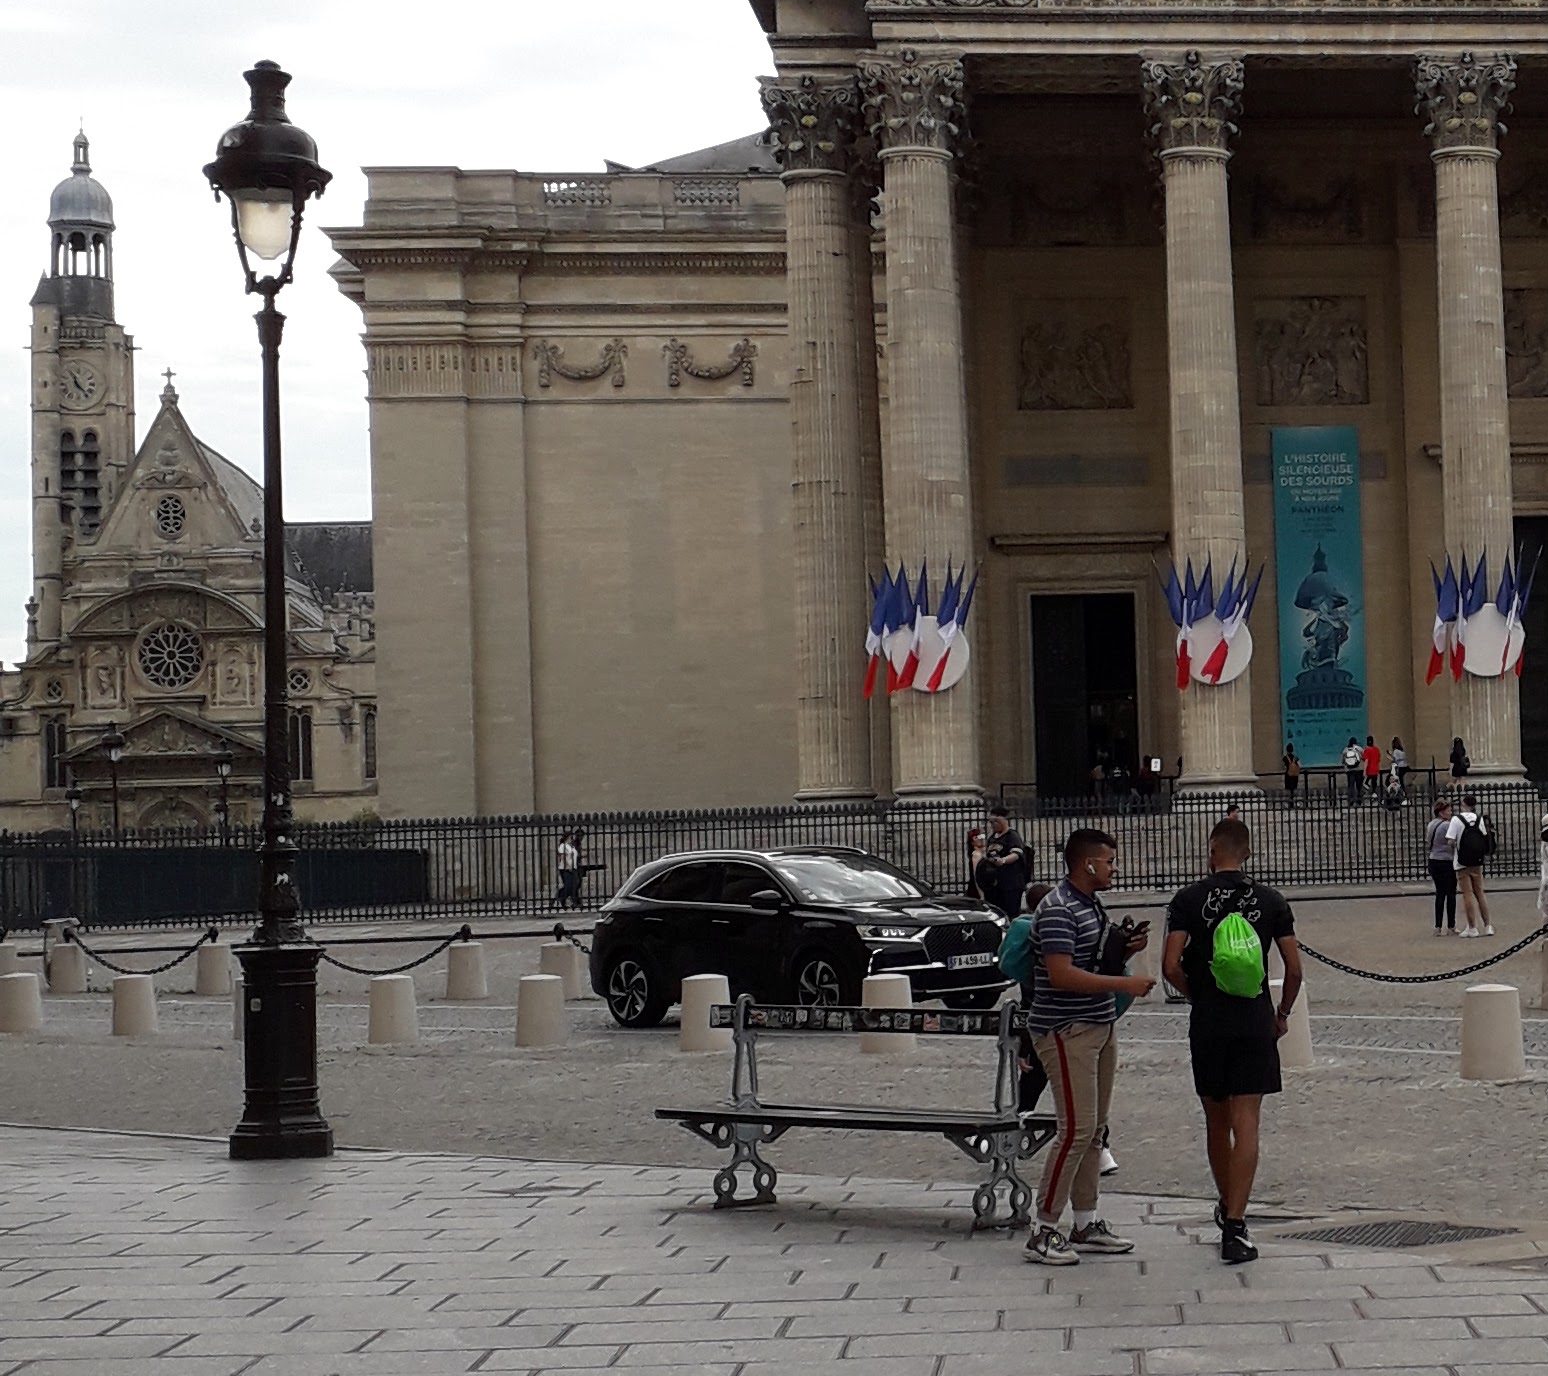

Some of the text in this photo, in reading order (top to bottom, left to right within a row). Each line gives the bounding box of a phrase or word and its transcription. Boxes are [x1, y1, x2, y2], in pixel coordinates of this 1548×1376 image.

[1278, 465, 1354, 475] SILENCIEUSE
[1280, 476, 1354, 486] DES SOURDS
